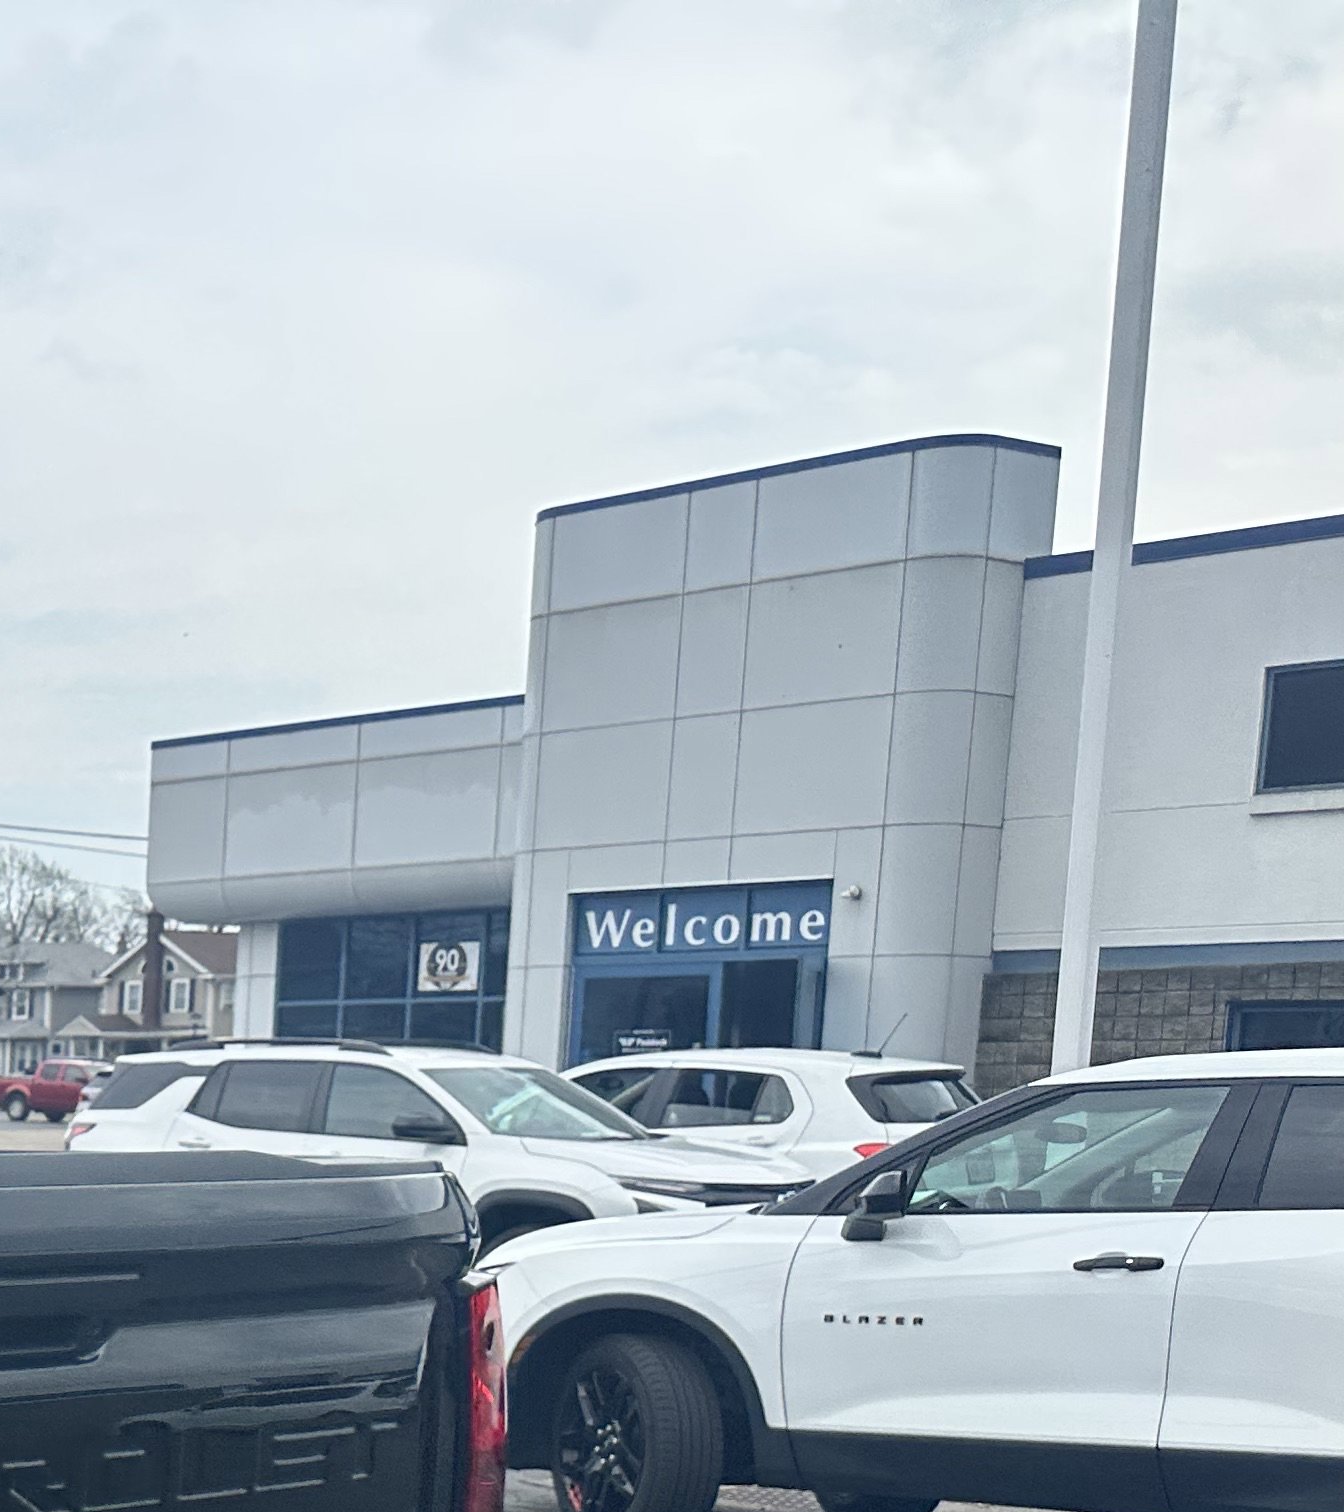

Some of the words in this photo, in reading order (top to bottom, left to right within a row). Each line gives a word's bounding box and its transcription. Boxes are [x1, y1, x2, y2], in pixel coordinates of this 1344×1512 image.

[585, 903, 825, 948] Welcome
[435, 948, 460, 973] 90
[823, 1314, 924, 1326] BLAZER
